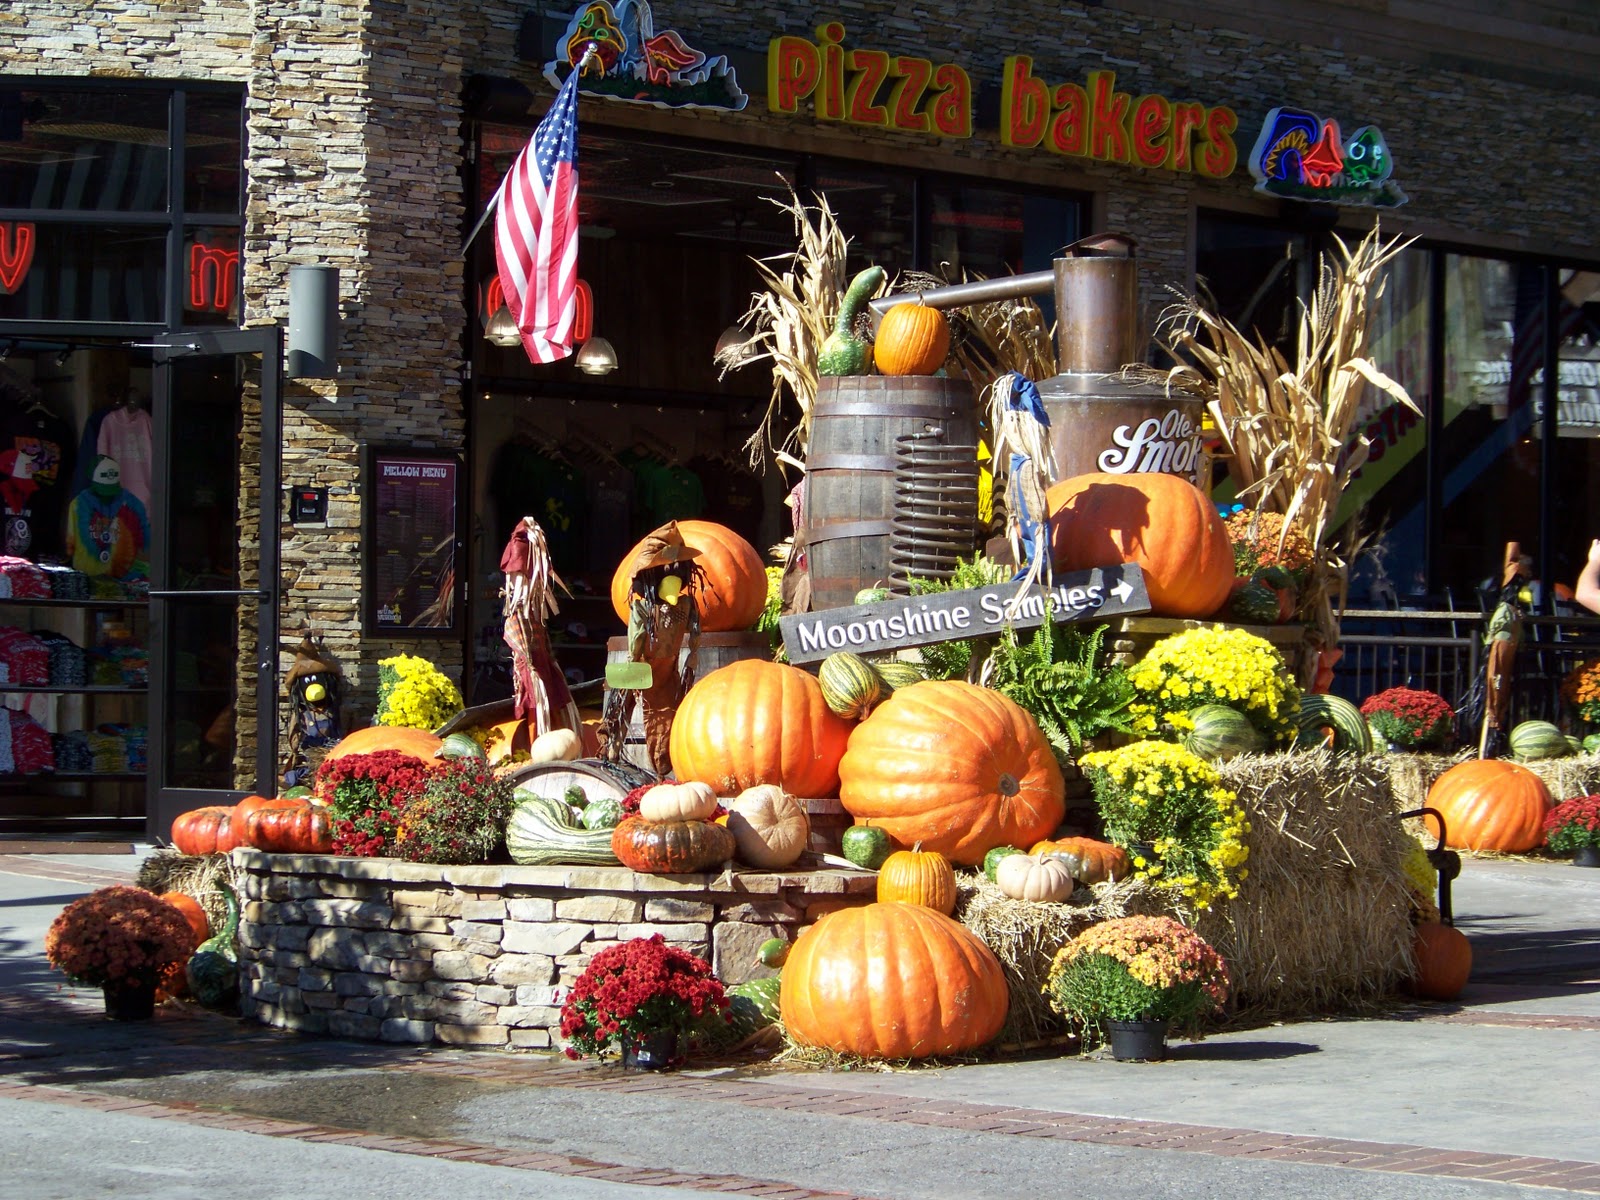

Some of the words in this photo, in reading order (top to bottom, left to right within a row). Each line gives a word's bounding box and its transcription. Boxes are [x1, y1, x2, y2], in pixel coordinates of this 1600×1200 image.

[768, 21, 972, 138] pizza
[1001, 55, 1238, 179] bakers
[1160, 409, 1194, 439] Ole
[383, 465, 420, 478] MELLOW
[422, 467, 447, 479] MENU
[797, 602, 970, 652] Moonshine
